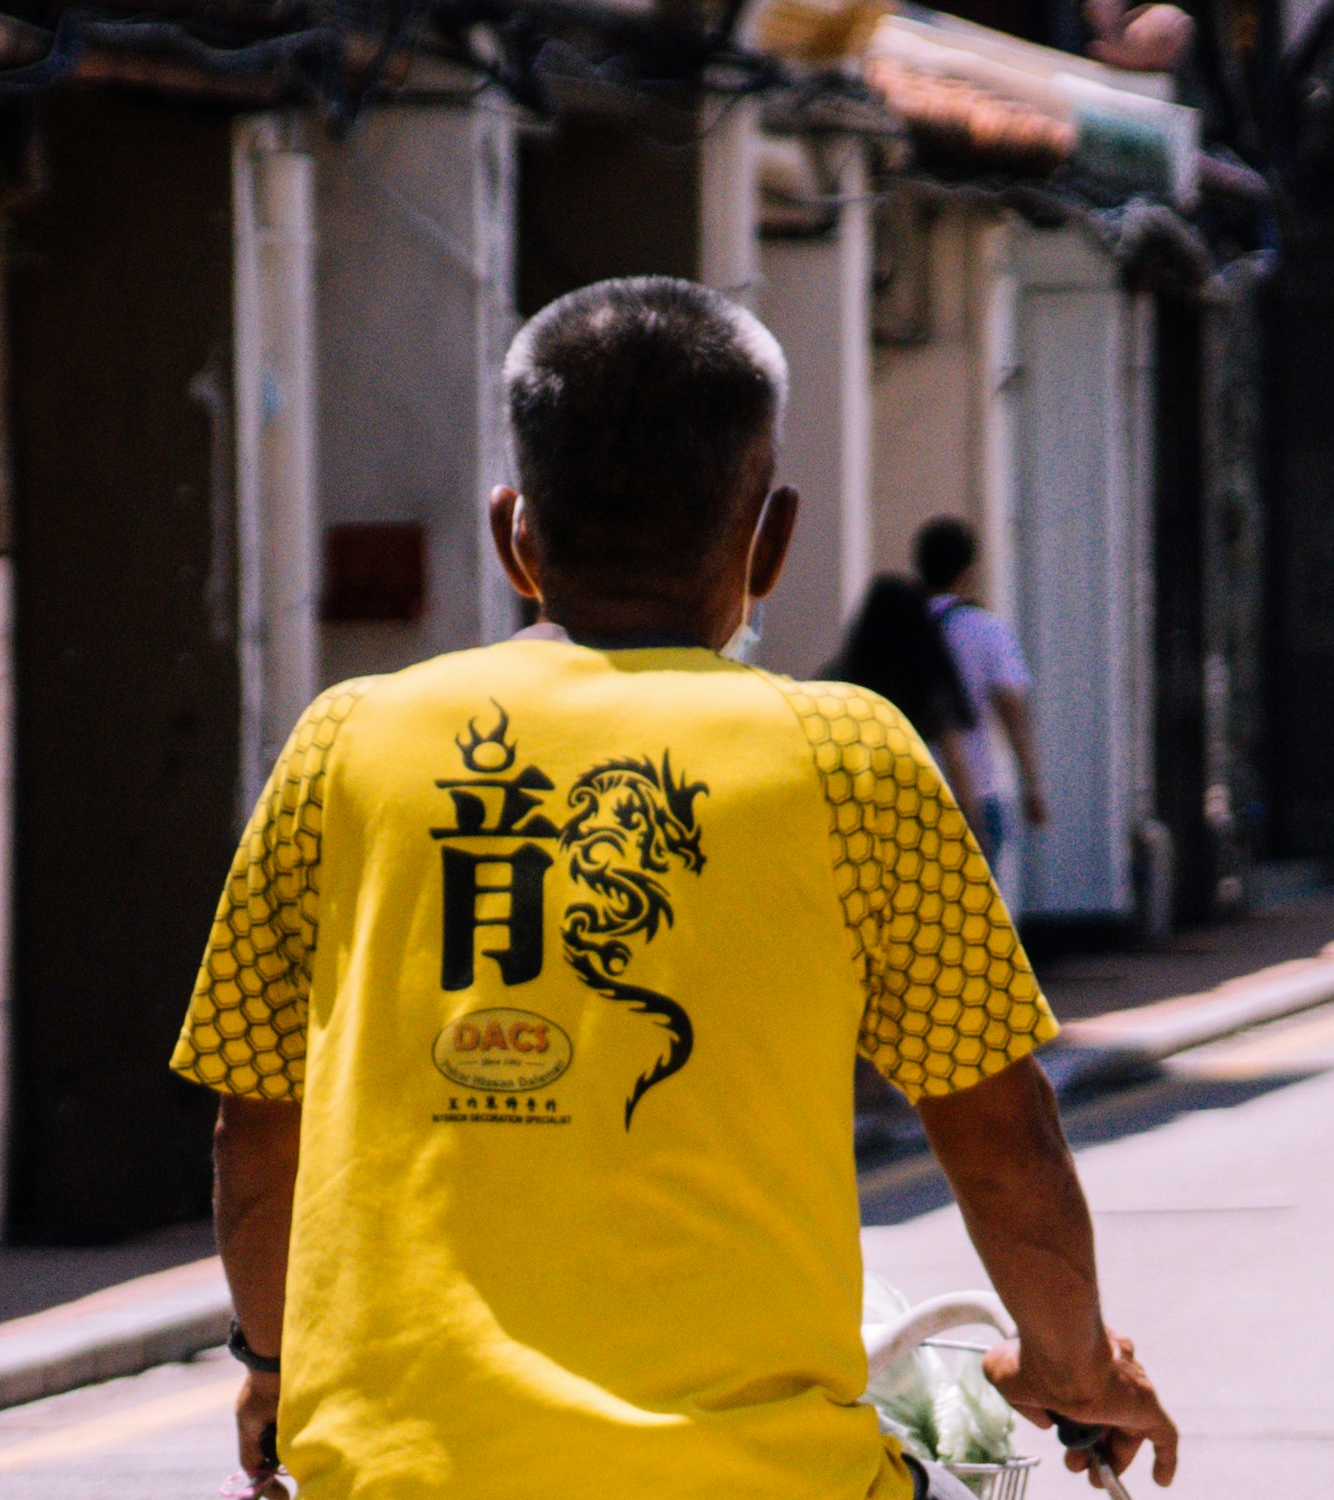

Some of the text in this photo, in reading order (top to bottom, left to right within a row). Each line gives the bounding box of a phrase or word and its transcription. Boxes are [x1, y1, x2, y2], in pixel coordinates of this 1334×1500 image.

[452, 1020, 551, 1053] DACS
[470, 1113, 523, 1124] DECORATION
[525, 1114, 572, 1125] SPECIALIST
